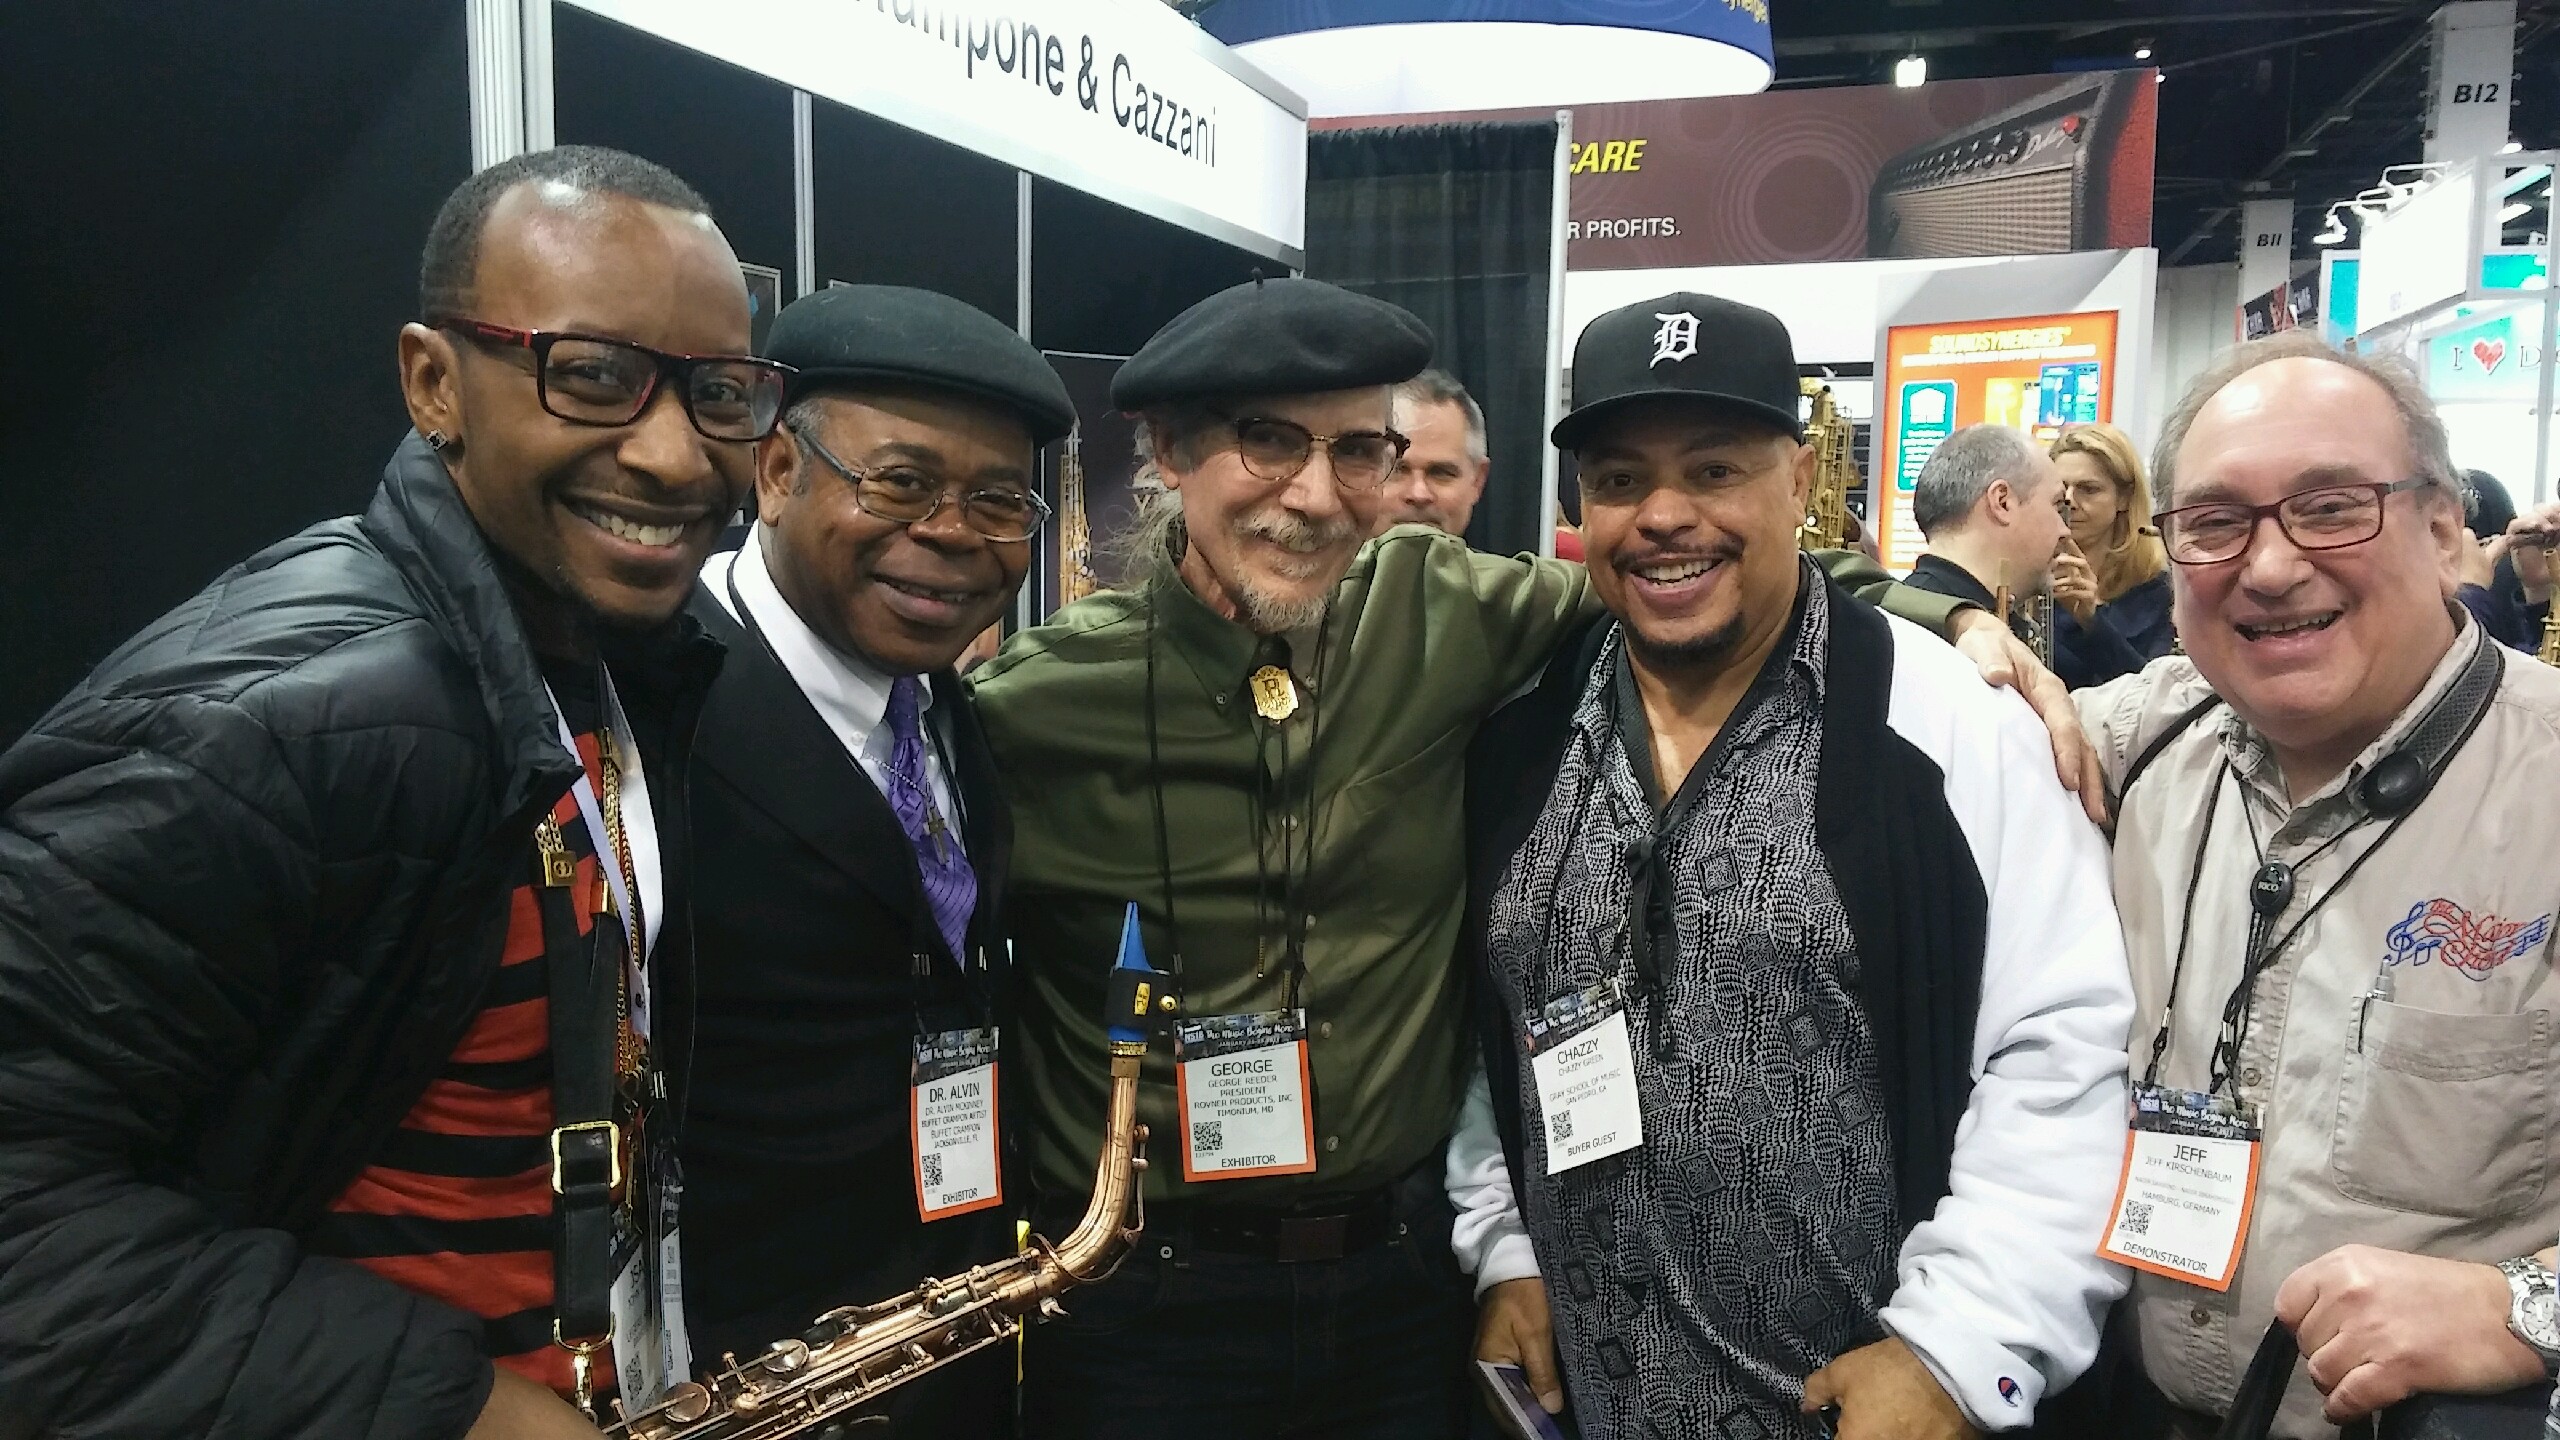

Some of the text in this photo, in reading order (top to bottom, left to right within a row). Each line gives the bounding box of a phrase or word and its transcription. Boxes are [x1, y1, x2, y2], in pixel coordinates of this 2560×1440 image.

[857, 0, 1216, 168] ampone & Cazzani
[2453, 83, 2499, 104] B12
[1586, 217, 1682, 239] PROFITS.
[2256, 233, 2282, 248] B11
[1649, 311, 1702, 370] D
[1558, 1038, 1598, 1064] CHAZZY
[1211, 1060, 1273, 1076] GEORGE
[930, 1082, 979, 1102] DR. ALVIN
[1208, 1078, 1241, 1088] GEORGE
[1220, 1086, 1266, 1097] PRESIDENT
[1568, 1141, 1591, 1156] BUYER
[1593, 1132, 1616, 1148] GUEST
[2174, 1144, 2207, 1163] JEFF
[1221, 1155, 1276, 1168] EXHIBITOR
[2166, 1162, 2232, 1183] KIRSCHENBAUM
[943, 1188, 978, 1204] EXHIBITOR
[2183, 1201, 2221, 1216] GERMANY
[2124, 1242, 2208, 1273] DEMONSTRATOR
